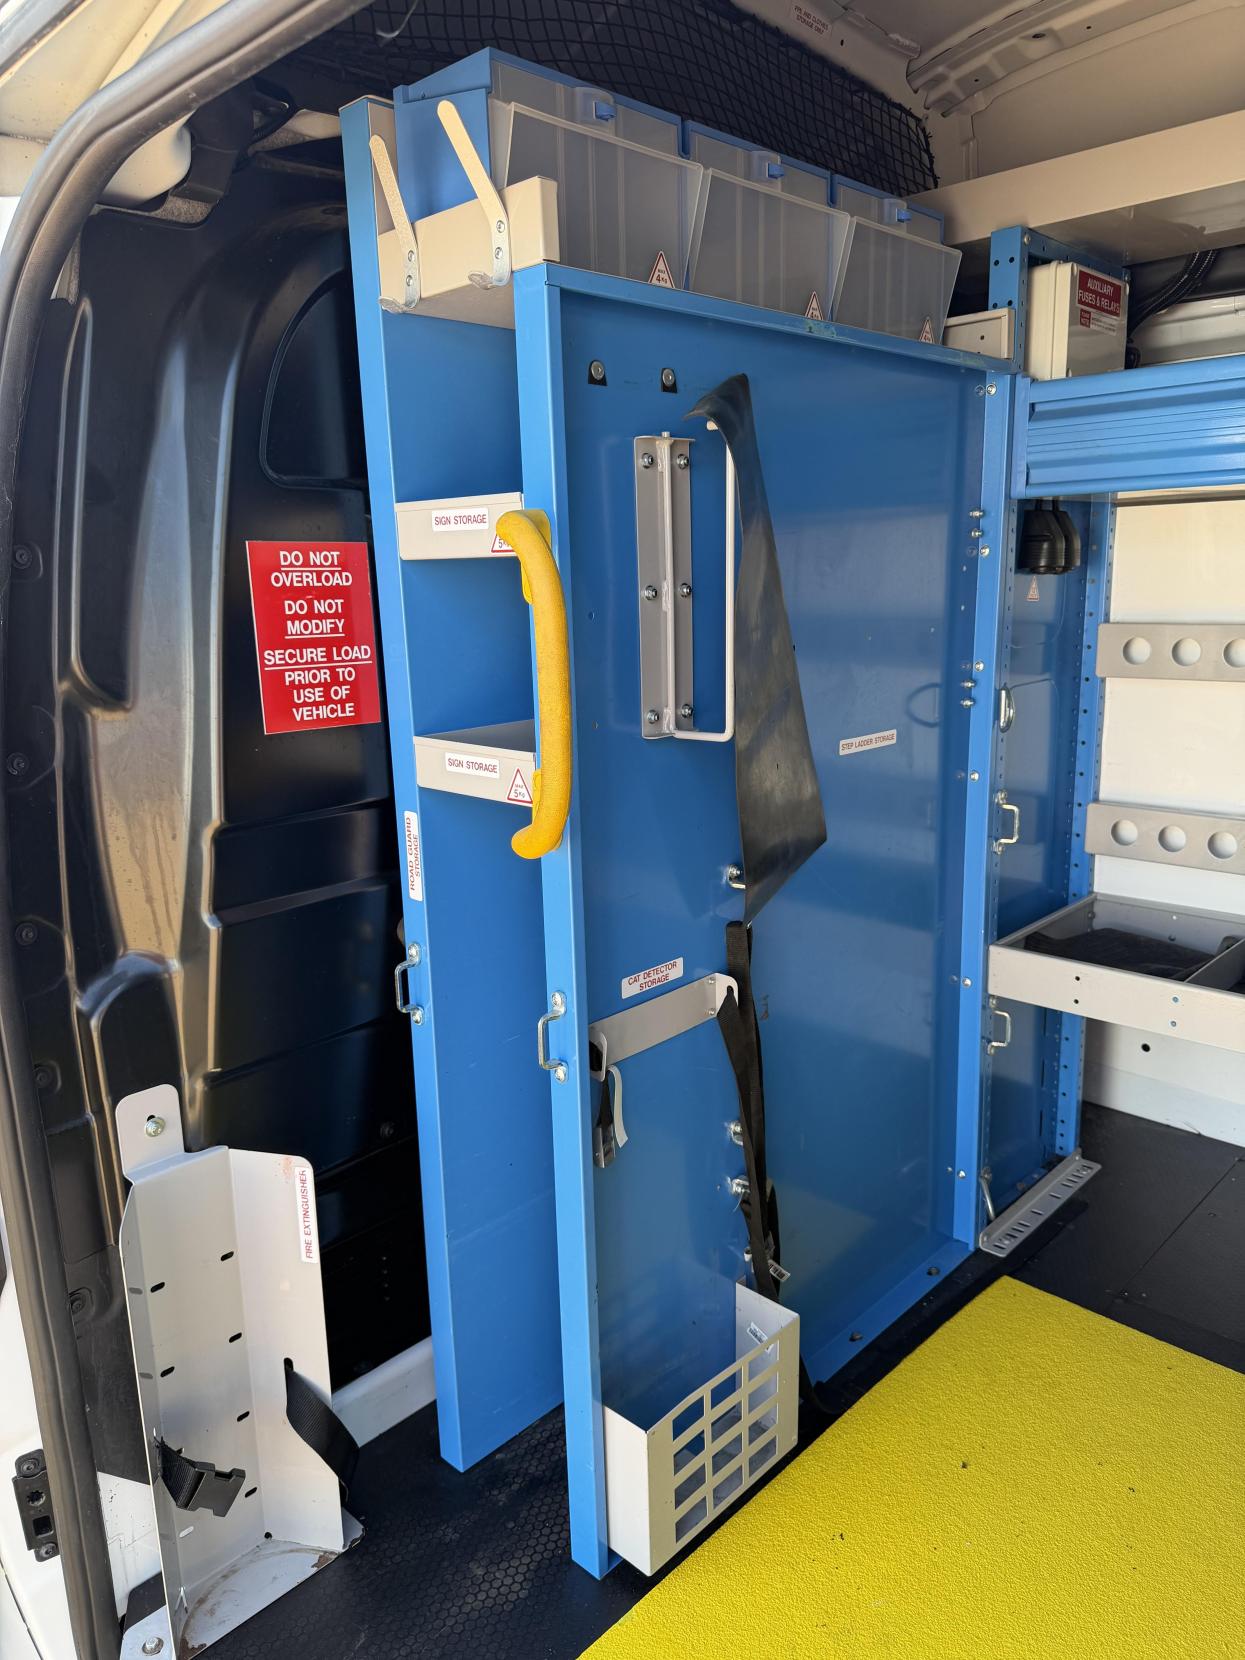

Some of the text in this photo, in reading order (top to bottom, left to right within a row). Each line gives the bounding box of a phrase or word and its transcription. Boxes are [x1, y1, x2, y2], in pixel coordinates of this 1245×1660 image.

[1087, 277, 1114, 297] AUXILIARY
[1078, 289, 1120, 313] FUSES & RELAYS
[434, 514, 487, 525] SIGN STORAGE
[279, 551, 340, 565] DO NOT
[271, 572, 352, 587] OVERLOAD
[284, 599, 344, 614] DO NOT
[287, 619, 345, 634] MODIFY
[264, 645, 371, 665] SECURE LOAD
[285, 667, 356, 685] PRIOR TO
[293, 686, 350, 703] USE OF
[292, 703, 355, 721] VEHICLE
[841, 733, 895, 750] STEP LADDER STORAGE
[447, 757, 498, 773] SIGN STORAGE
[627, 961, 677, 985] CAT DETECTOR
[639, 973, 670, 991] STORAGE
[299, 1170, 313, 1258] FIRE EXTINGUISHER
